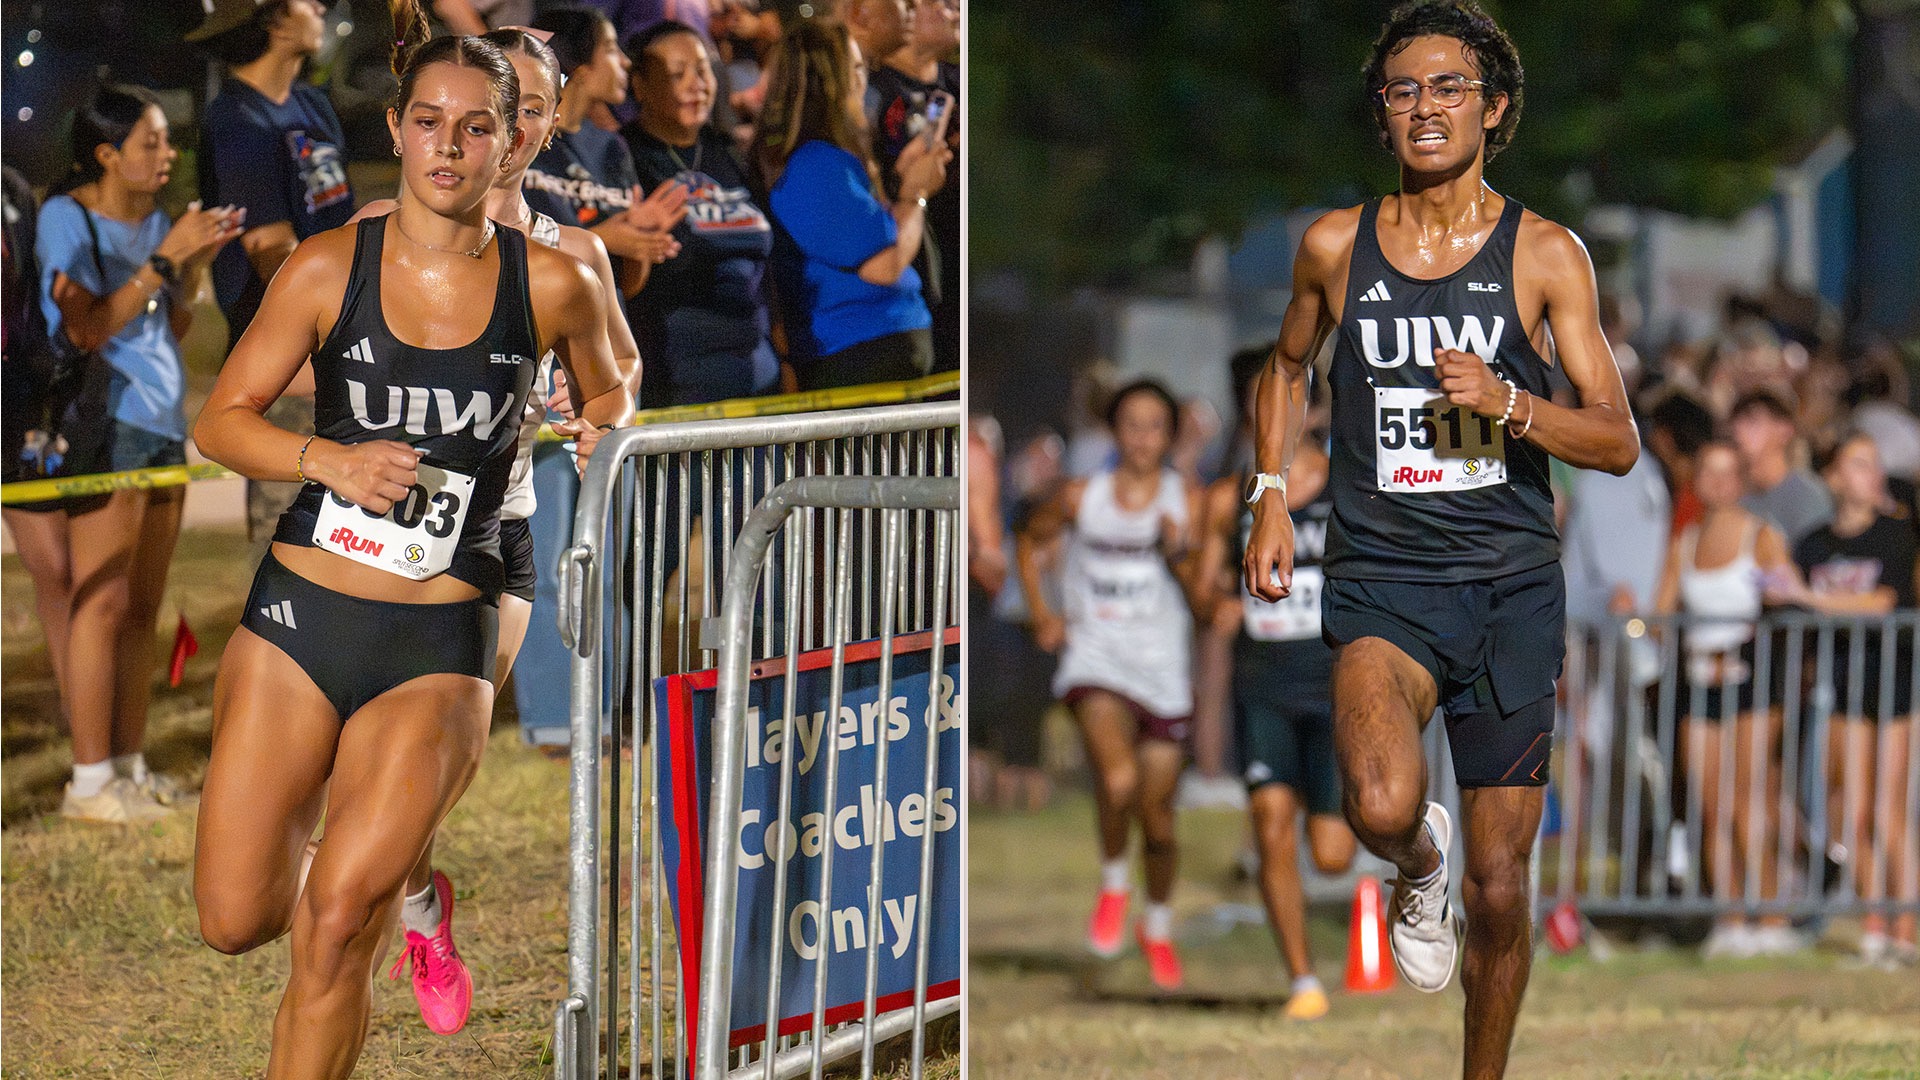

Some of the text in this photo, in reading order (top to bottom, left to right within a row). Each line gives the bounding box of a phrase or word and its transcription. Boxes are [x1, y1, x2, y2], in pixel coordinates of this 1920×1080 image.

[1357, 315, 1505, 369] UIW
[346, 378, 515, 441] UIW
[1380, 407, 1492, 450] 5511
[331, 483, 460, 539] 03
[745, 696, 911, 776] layers
[738, 784, 957, 870] Coaches
[789, 885, 917, 960] Ony
